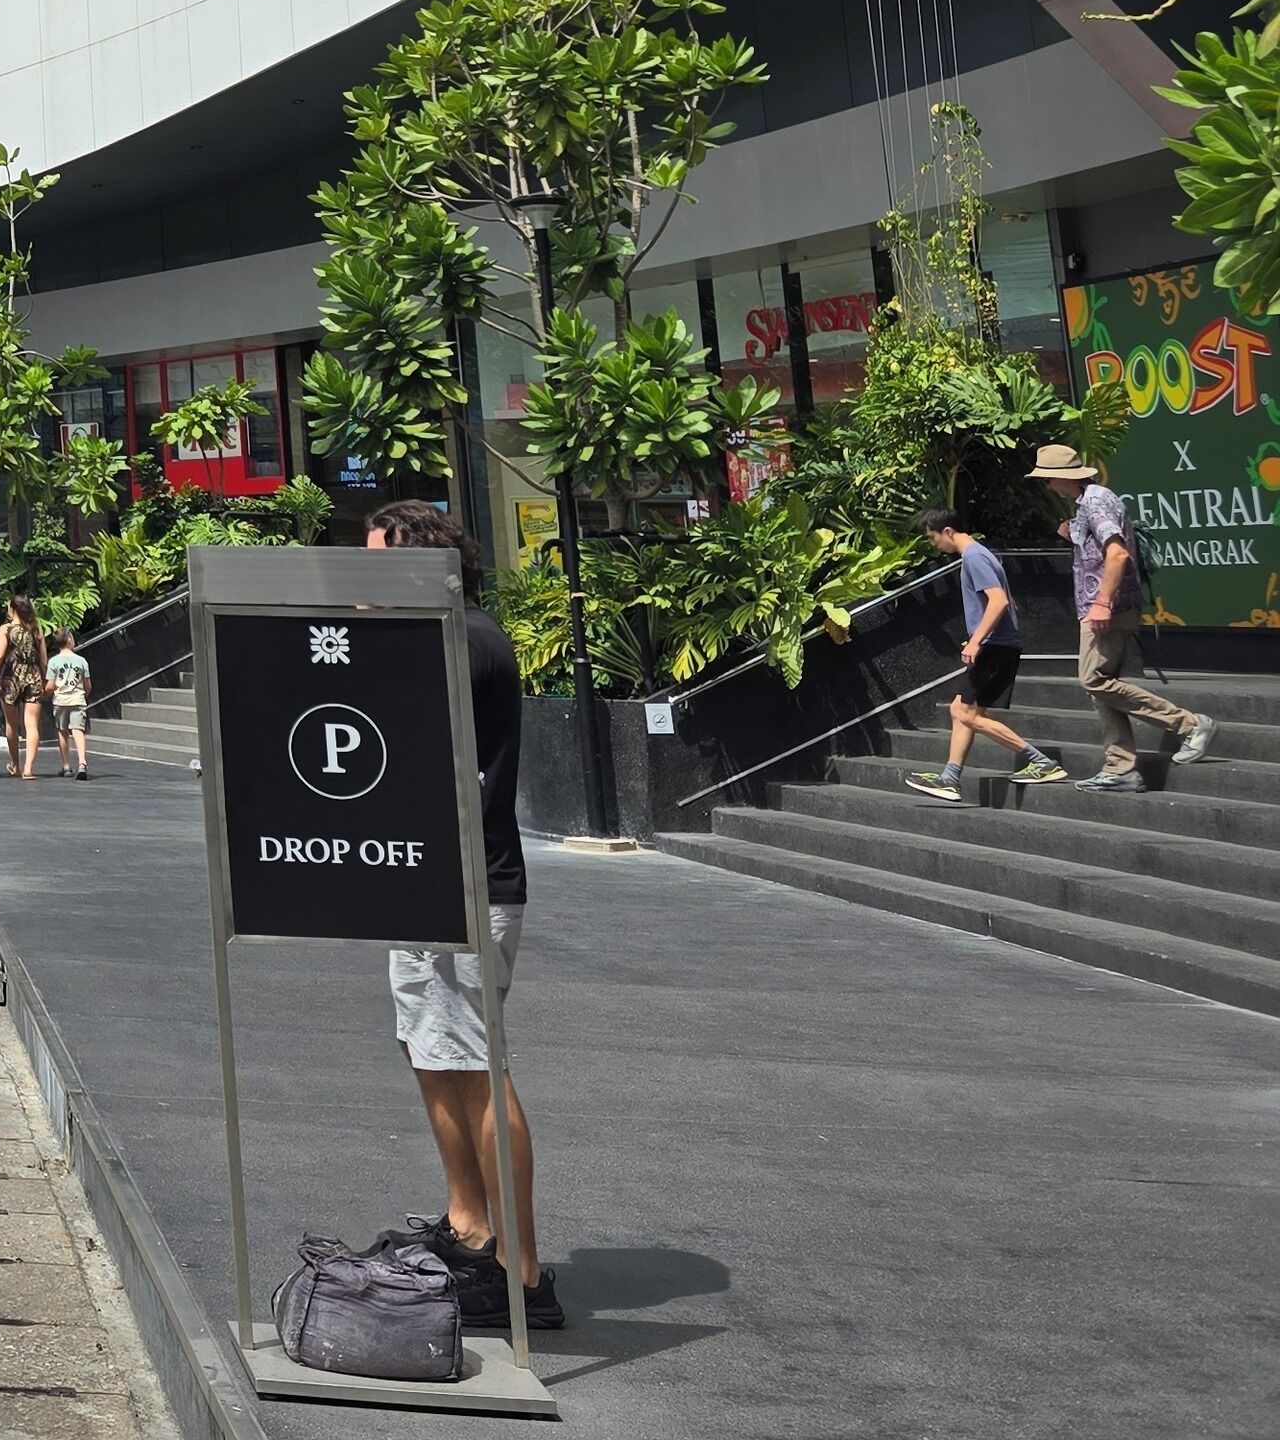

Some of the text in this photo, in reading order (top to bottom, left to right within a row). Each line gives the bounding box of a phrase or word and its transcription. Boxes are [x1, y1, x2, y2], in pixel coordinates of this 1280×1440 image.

[1172, 439, 1197, 472] X
[321, 722, 362, 775] P
[259, 835, 425, 868] DROP OFF
